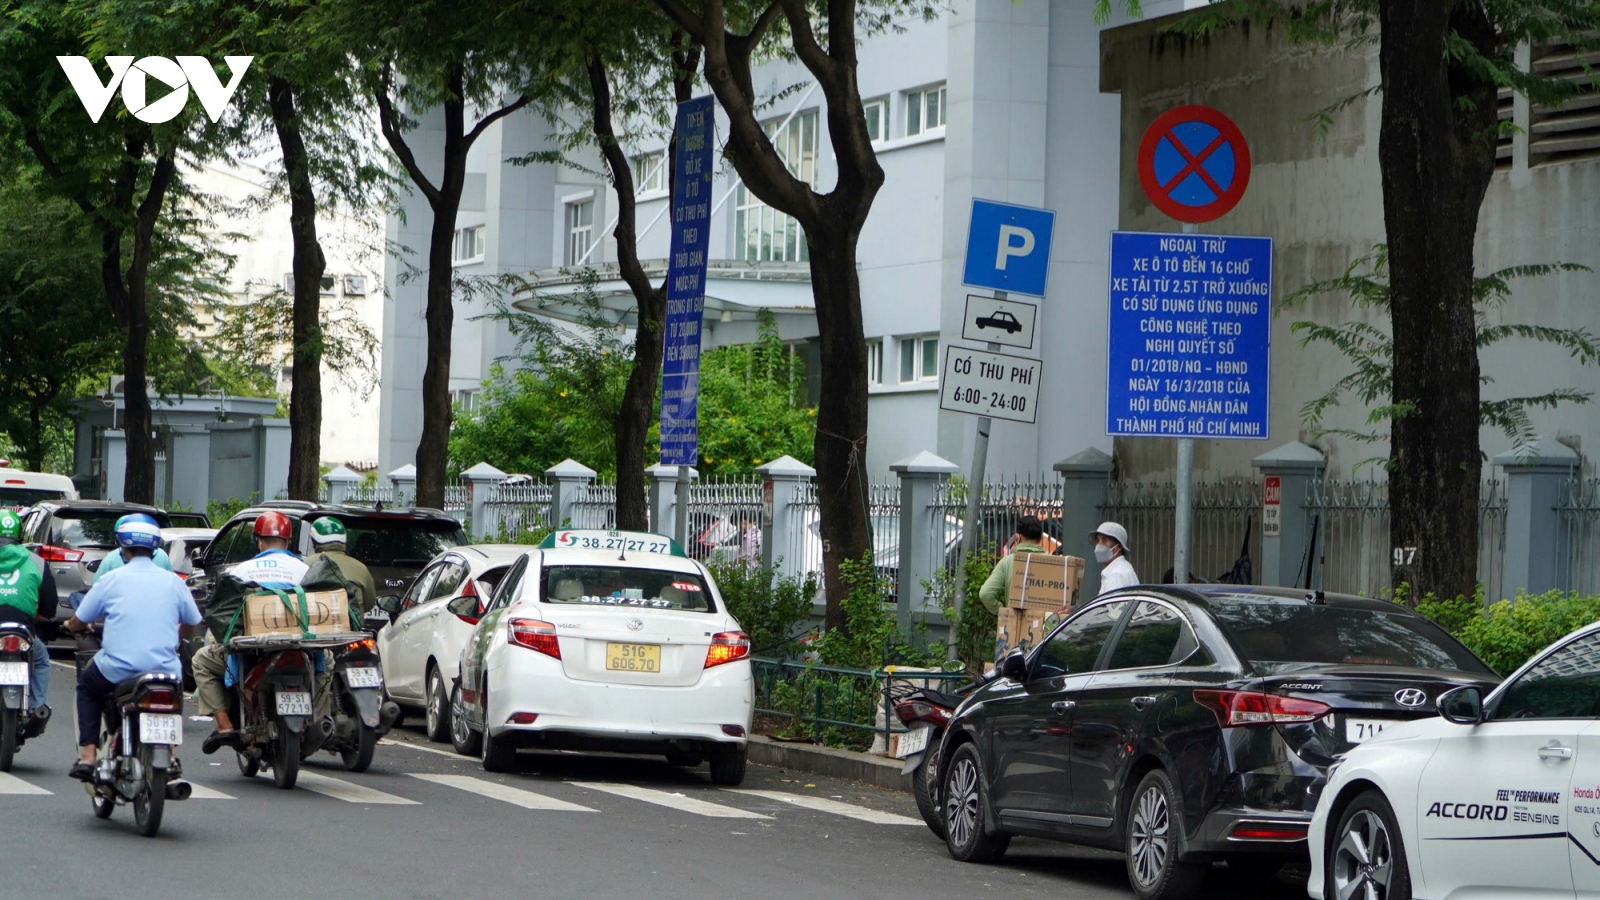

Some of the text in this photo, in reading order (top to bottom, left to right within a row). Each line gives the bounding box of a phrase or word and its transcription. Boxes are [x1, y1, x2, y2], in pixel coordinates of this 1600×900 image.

[694, 157, 702, 174] XE
[676, 199, 708, 222] CÓ THU PHÍ
[683, 227, 698, 244] THEO
[995, 224, 1035, 271] P
[1160, 237, 1226, 255] NGOẠI TRỪ
[1133, 255, 1253, 275] XE Ô TÔ ĐẾN 16 CHỖ
[689, 269, 700, 290] PHÍ
[1113, 278, 1128, 291] XE
[1132, 275, 1150, 292] TẢI
[1154, 276, 1170, 293] TỪ
[1203, 277, 1225, 294] TRỞ
[1228, 277, 1268, 296] XUỐNG
[667, 299, 686, 315] TRONG
[1122, 294, 1258, 317] CÓ SỬ DỤNG ỨNG DỤNG
[670, 319, 678, 338] TỪ
[1140, 318, 1242, 336] CÔNG NGHỆ THEO
[667, 340, 678, 361] ĐẾN
[1146, 337, 1237, 355] NGHỊ QUYẾT SỐ
[954, 356, 1035, 385] CÓ THU PHÍ
[1131, 358, 1201, 374] 01/2018/NQ
[1216, 361, 1248, 375] HĐND
[1129, 375, 1250, 394] NGÀY 16/3/2018 CỦA
[1129, 394, 1248, 415] HỘI ĐỒNG NHÂN DÂN
[1117, 415, 1260, 435] THÀNH PHỐ HỒ CHÍ MINH
[1266, 480, 1280, 502] CẤM
[582, 537, 667, 554] 38.27 27 27
[1393, 546, 1417, 566] 97
[622, 645, 646, 657] 51G
[612, 657, 655, 671] 606.70
[278, 703, 310, 714] 572.19
[900, 741, 922, 756] 7717
[1514, 790, 1561, 804] PERFORMANCE
[1573, 787, 1594, 799] Honda
[1426, 802, 1508, 821] ACCORD
[1513, 812, 1560, 825] SENSING
